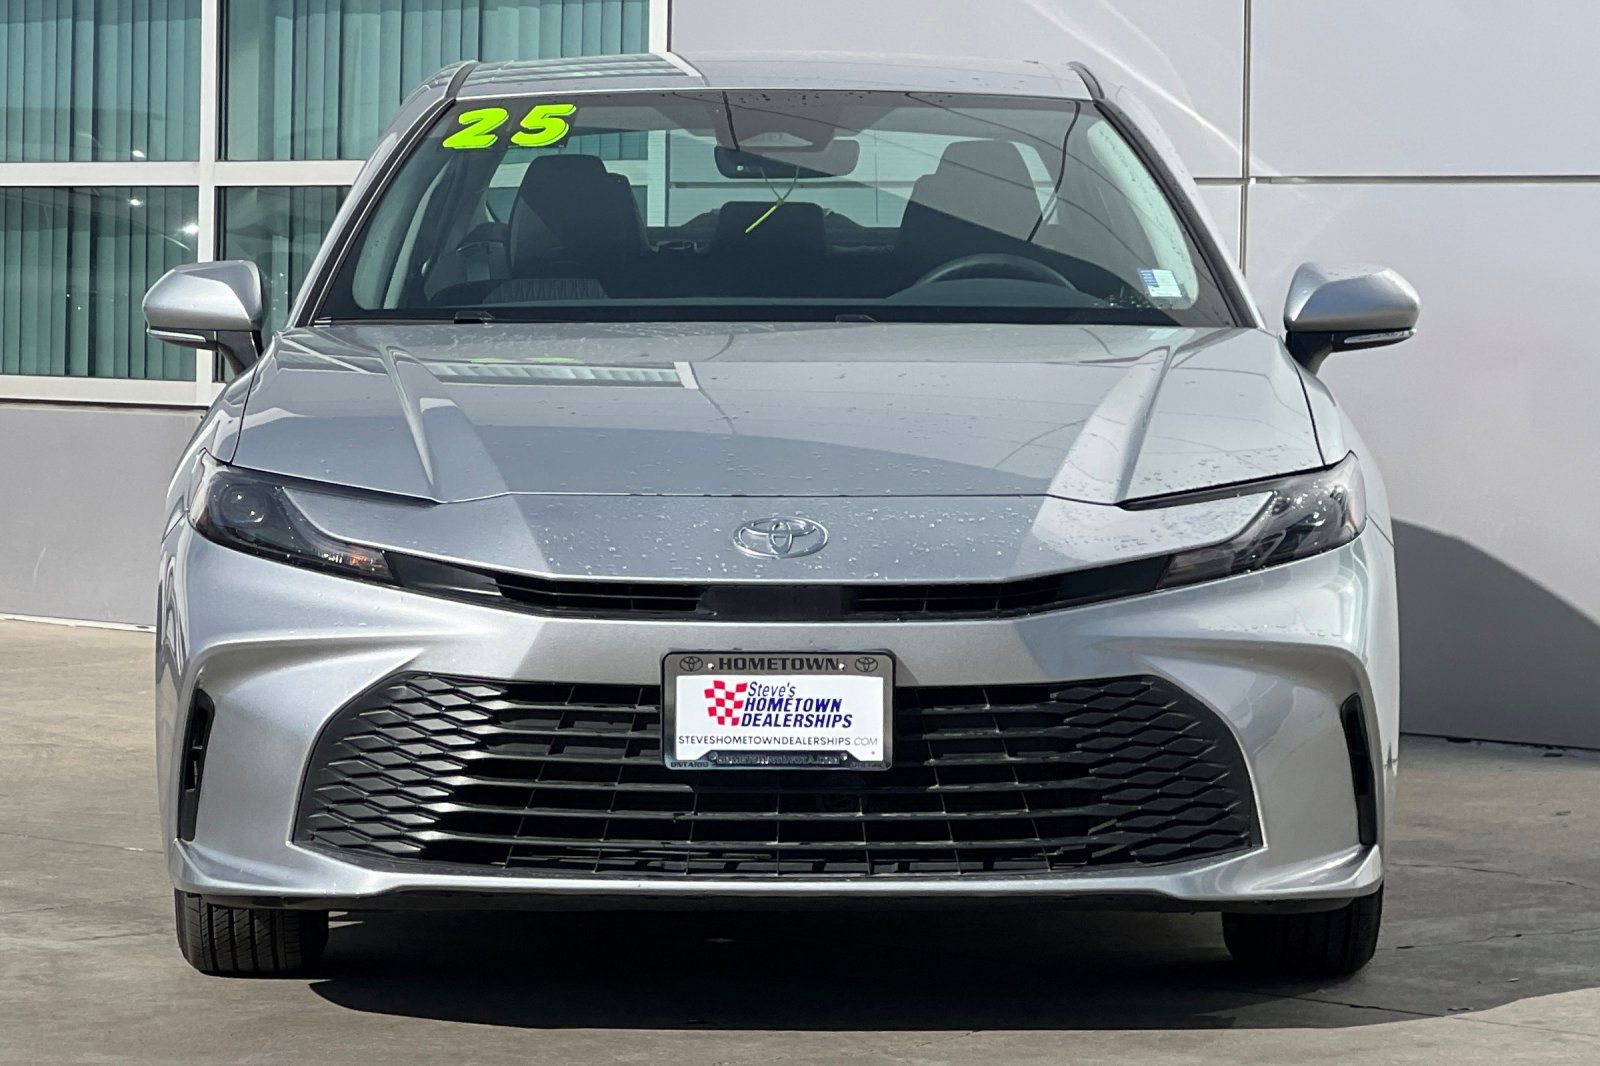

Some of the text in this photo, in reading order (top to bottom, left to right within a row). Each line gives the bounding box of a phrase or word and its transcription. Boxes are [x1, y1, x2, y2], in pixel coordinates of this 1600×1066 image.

[442, 104, 577, 149] 25
[718, 657, 840, 671] HOMETOWN
[747, 681, 797, 698] Steve's
[744, 697, 843, 713] HOMETOWN
[740, 713, 853, 729] DEALERSHIPS
